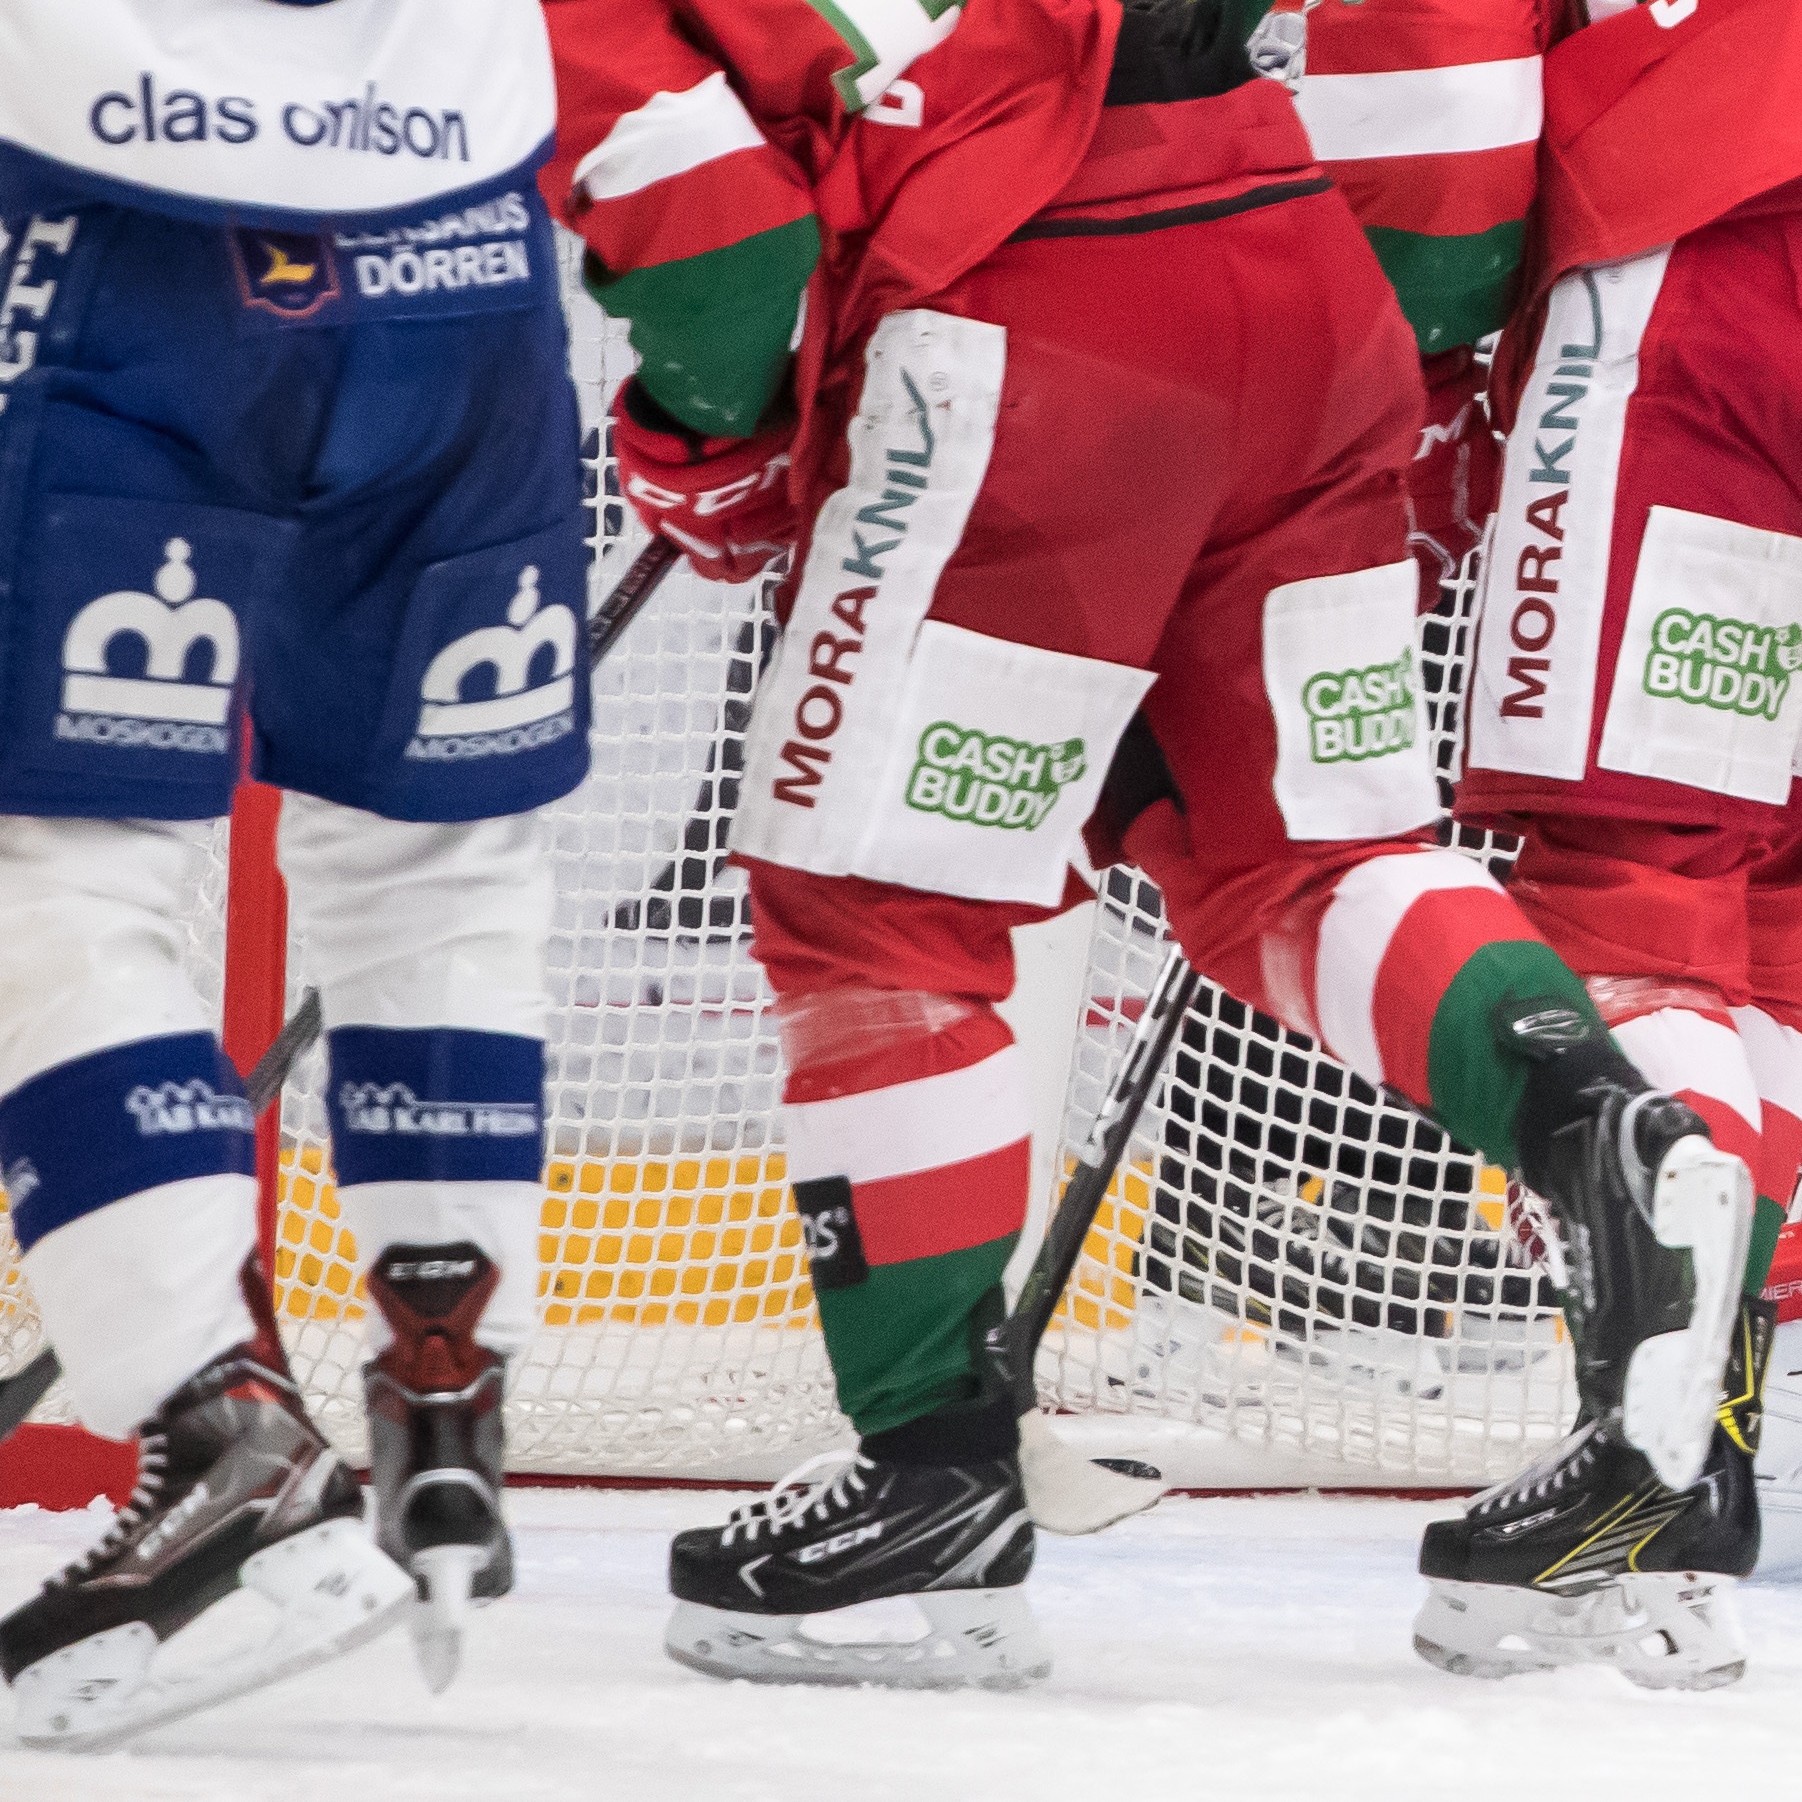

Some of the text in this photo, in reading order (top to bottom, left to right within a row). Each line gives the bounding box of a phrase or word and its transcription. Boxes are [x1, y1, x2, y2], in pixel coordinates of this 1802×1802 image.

[90, 70, 259, 145] clas
[355, 236, 531, 297] DÖRREN
[1655, 611, 1776, 667] CASH
[1306, 674, 1403, 721] CASH
[1648, 660, 1789, 716] BUDDY
[925, 727, 1050, 788] CASH
[1313, 716, 1415, 760] BUDDY
[912, 769, 1054, 825] BUDDY
[799, 1520, 884, 1565] CCM
